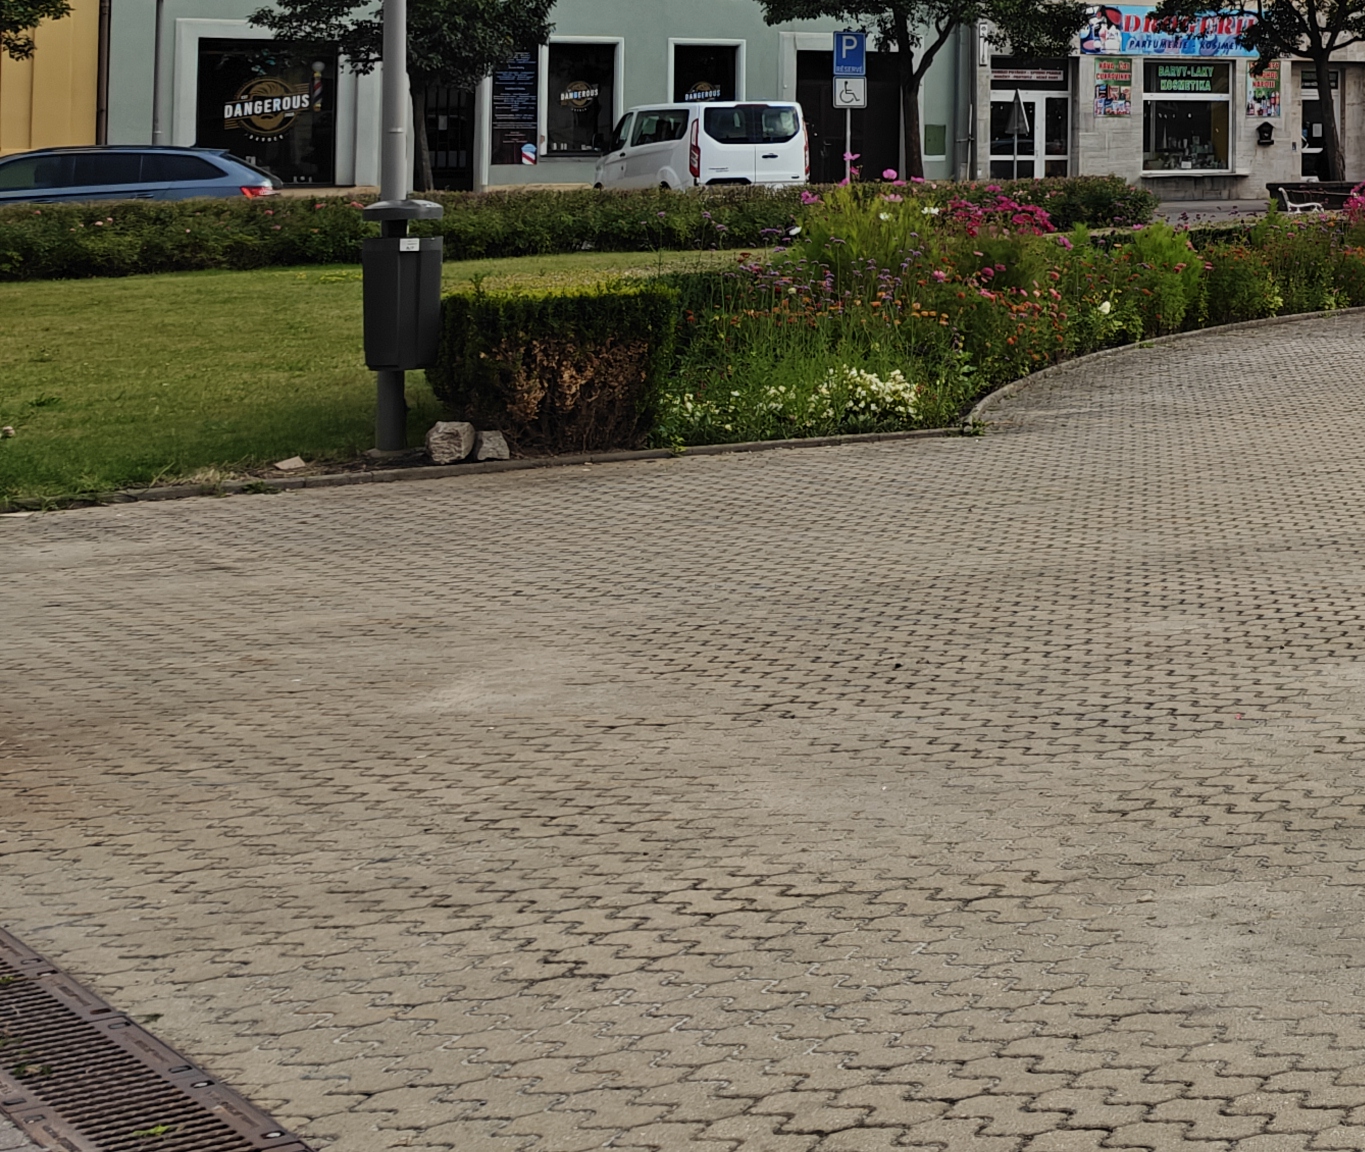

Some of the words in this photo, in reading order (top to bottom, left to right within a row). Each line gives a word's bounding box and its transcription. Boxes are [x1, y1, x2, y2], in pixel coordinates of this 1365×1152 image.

[842, 35, 857, 59] P
[1129, 38, 1189, 49] PARFUMERIE
[1160, 79, 1212, 91] KOSMETIKA
[561, 89, 599, 101] DANGEROUS
[684, 89, 721, 101] DANGEROUS
[223, 94, 310, 119] DANGEROUS
